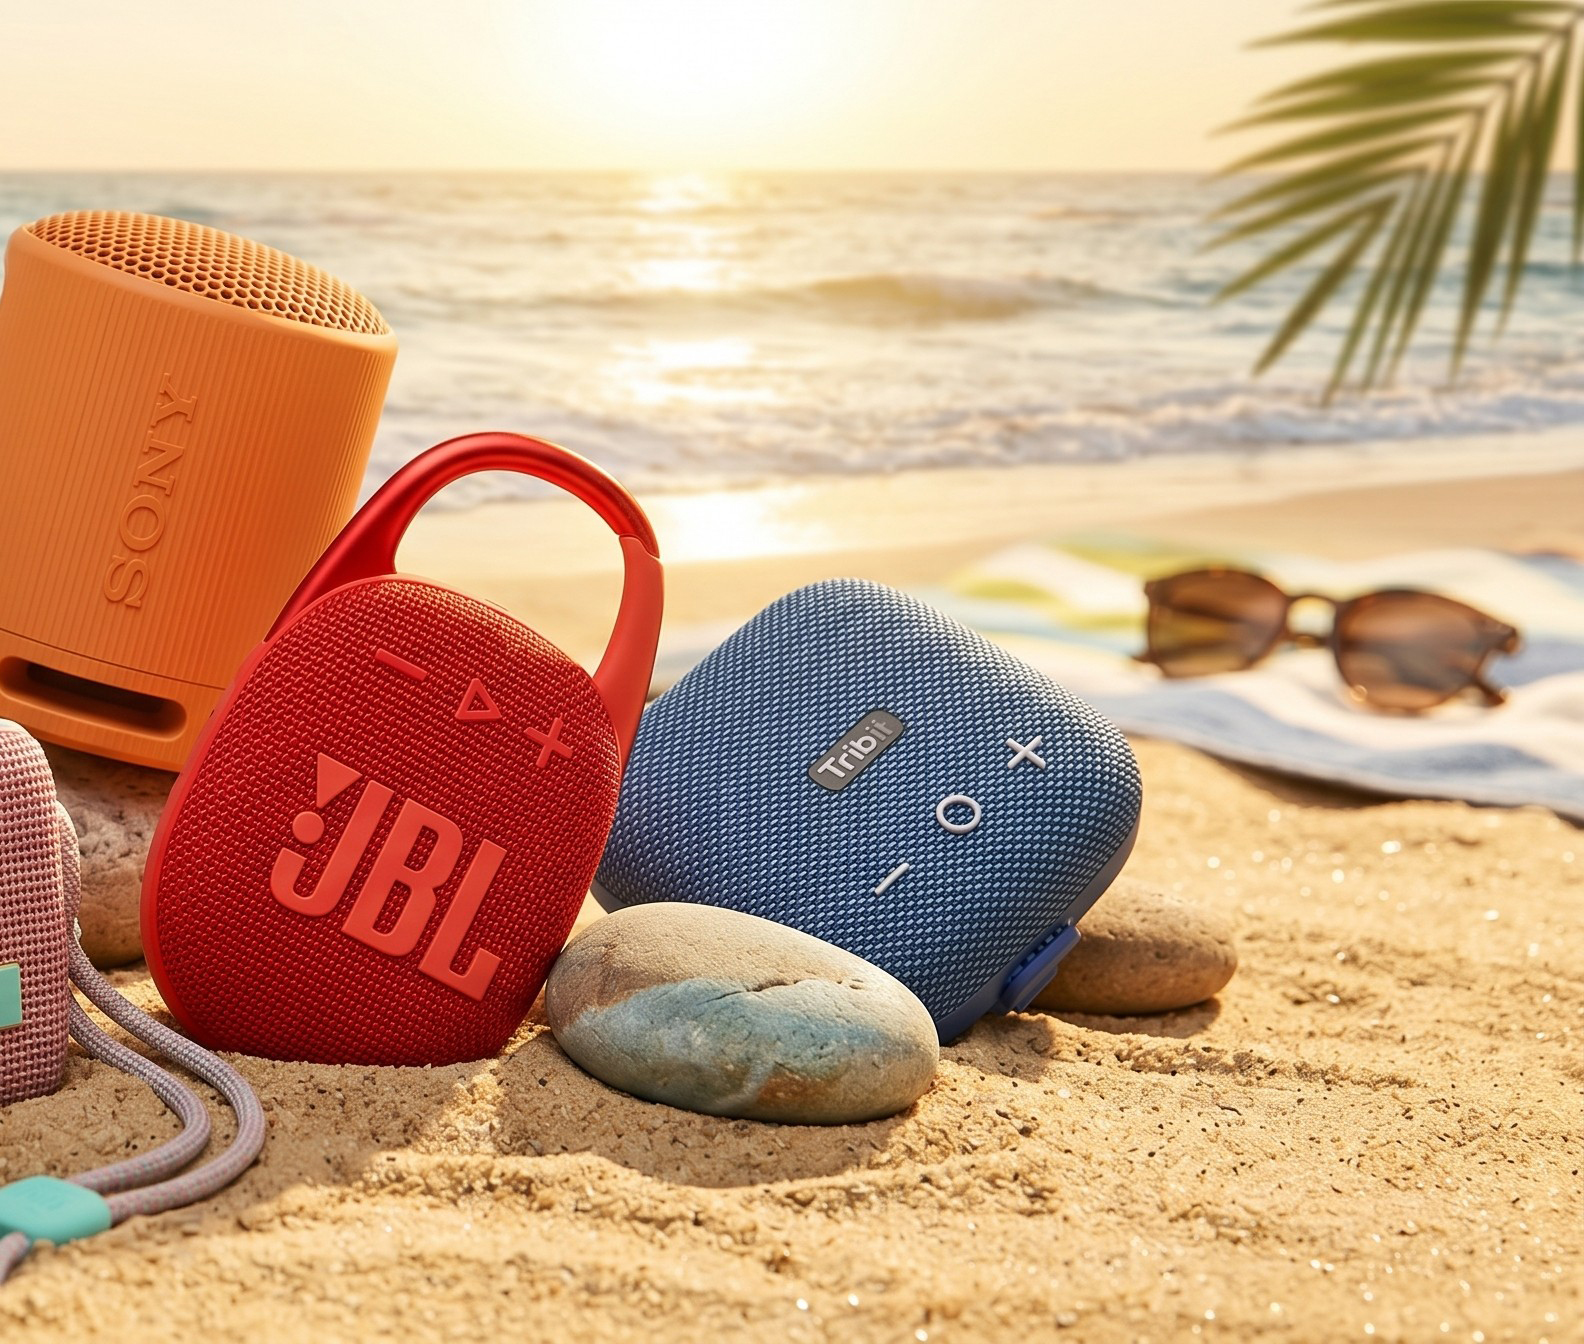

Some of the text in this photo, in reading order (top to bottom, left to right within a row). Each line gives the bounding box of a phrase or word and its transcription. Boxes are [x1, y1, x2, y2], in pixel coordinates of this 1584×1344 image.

[104, 373, 197, 608] SONY
[817, 719, 894, 778] Tribit
[270, 779, 508, 1000] JBL
